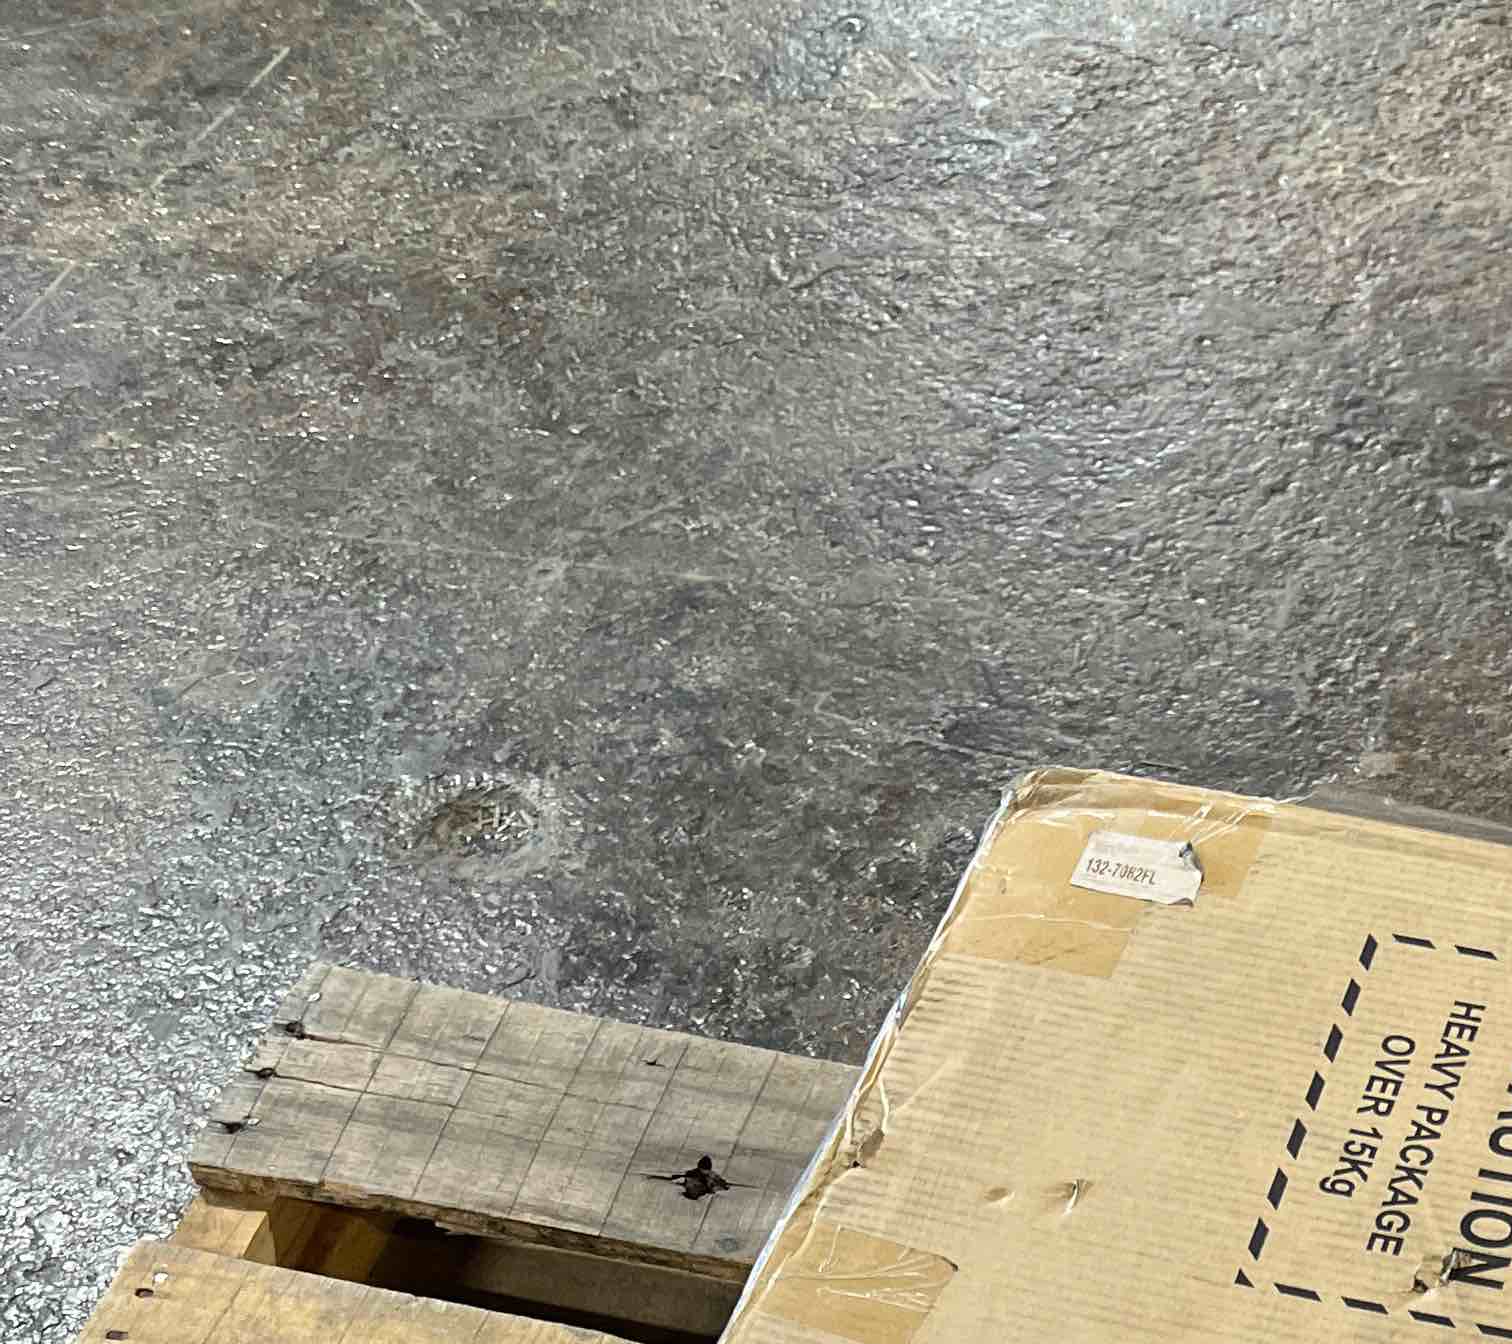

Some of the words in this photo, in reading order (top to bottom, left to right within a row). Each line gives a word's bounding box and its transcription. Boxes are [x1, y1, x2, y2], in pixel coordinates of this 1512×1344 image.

[1356, 1034, 1416, 1118] OVER
[1424, 1000, 1487, 1101] HEAVY
[1319, 1126, 1384, 1198] 15Kg
[1366, 1103, 1449, 1256] PACKAGE
